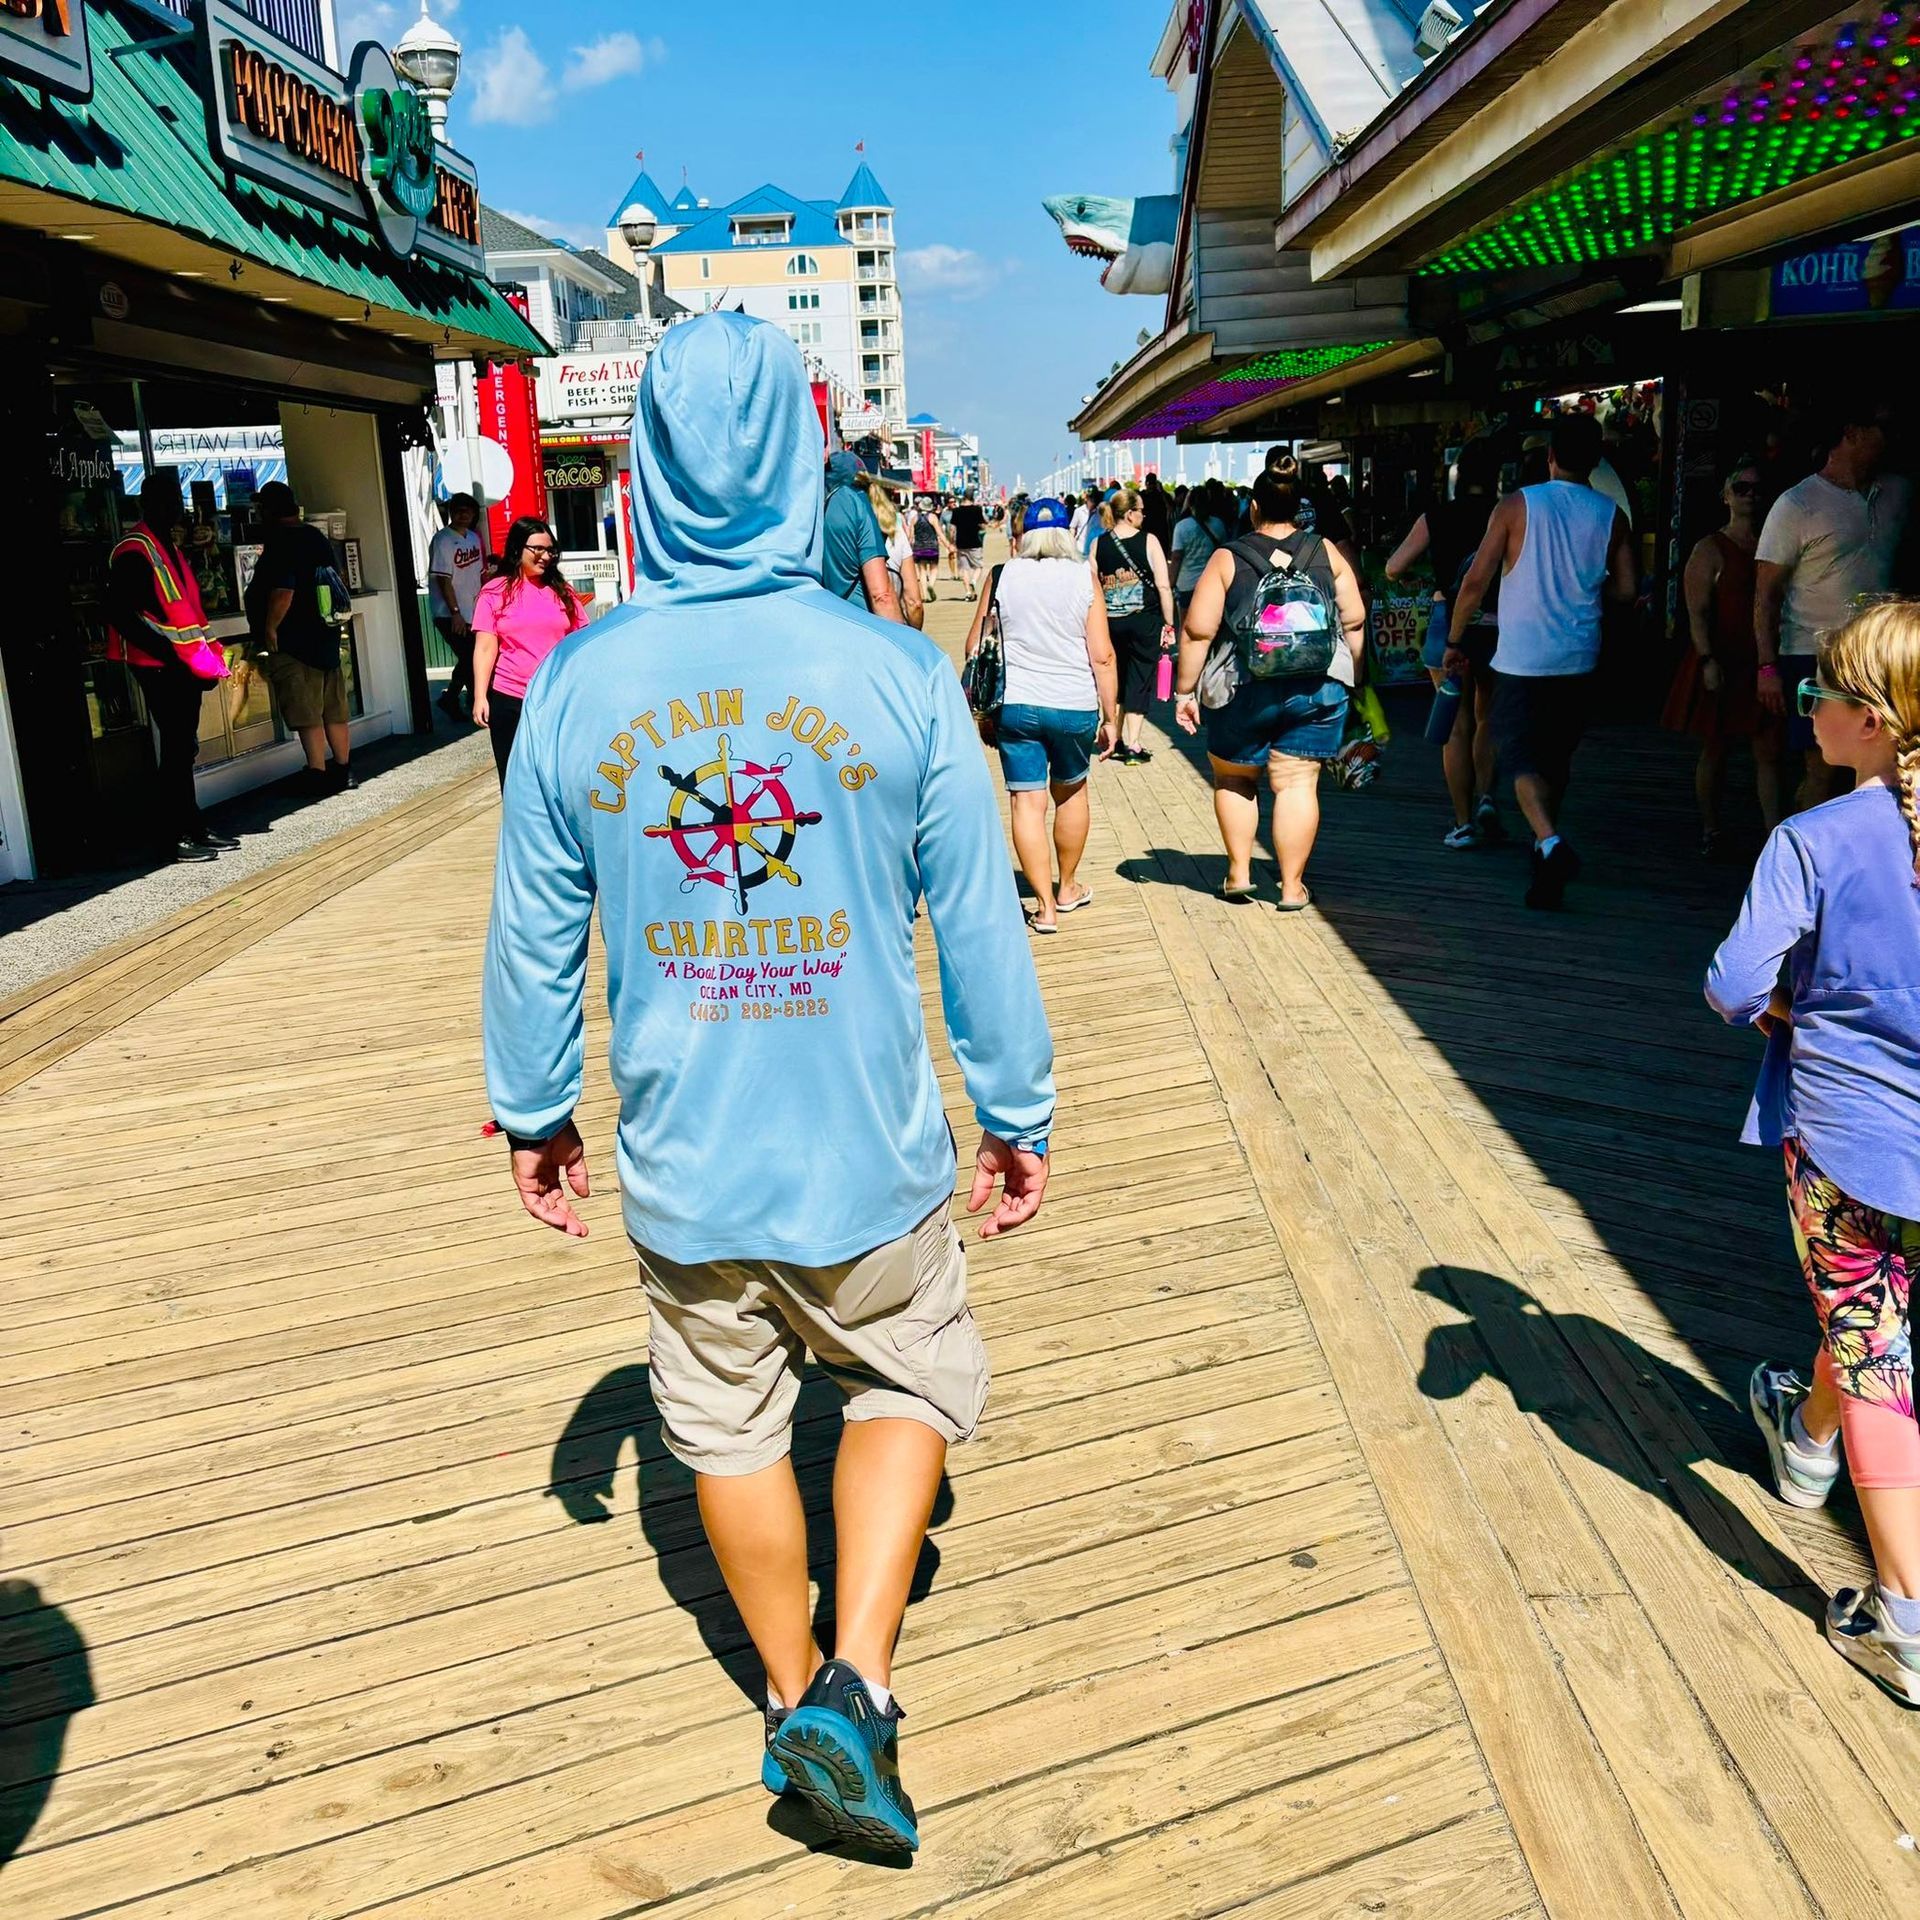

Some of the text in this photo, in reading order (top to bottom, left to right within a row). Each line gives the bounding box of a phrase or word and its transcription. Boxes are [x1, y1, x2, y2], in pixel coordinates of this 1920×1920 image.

[1780, 251, 1860, 287] KOHR
[559, 363, 610, 384] Fresh
[567, 387, 596, 397] BEEF
[567, 398, 599, 407] FISH
[67, 449, 111, 488] Apples
[543, 466, 603, 487] TACOS
[1372, 611, 1417, 628] 50%
[1376, 629, 1416, 647] OFF
[591, 689, 878, 814] CAPTAIN JOE'S
[644, 909, 851, 957] CHARTERS
[683, 962, 717, 980] Boat
[719, 963, 757, 983] Day
[760, 961, 798, 979] Your
[700, 982, 812, 1000] OCEAN CITY, MD
